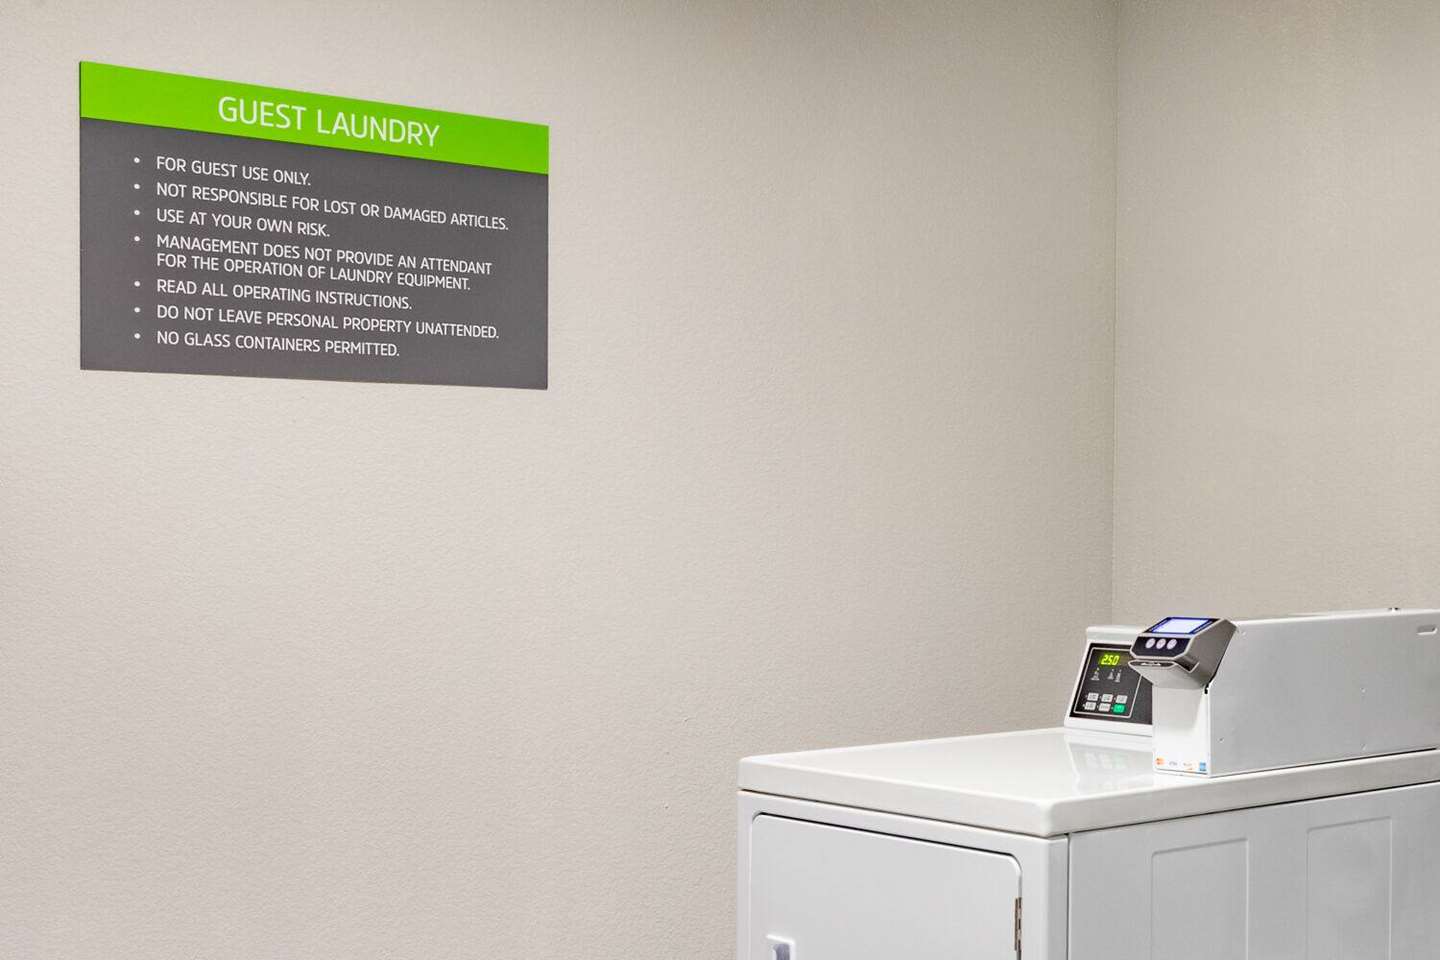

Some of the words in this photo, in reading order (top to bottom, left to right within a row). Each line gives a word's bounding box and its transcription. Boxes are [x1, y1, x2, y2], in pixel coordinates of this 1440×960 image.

[217, 95, 306, 130] GUEST
[316, 109, 439, 147] LAUNDRY
[156, 155, 187, 173] FOR
[190, 159, 238, 178] GUEST
[241, 164, 269, 182] USE
[272, 168, 312, 186] ONLY.
[156, 181, 188, 198] NOT
[191, 185, 288, 209] RESPONSIBLE
[291, 195, 320, 212] FOR
[323, 198, 357, 215] LOST
[359, 202, 380, 218] OR
[383, 204, 447, 224] DAMAGED
[449, 212, 509, 231] ARTICLES.
[156, 207, 185, 224] USE
[188, 210, 208, 226] AT
[210, 212, 252, 230] YOUR
[255, 216, 293, 234] OWN
[296, 220, 330, 238] RISK.
[156, 233, 259, 256] MANAGEMENT
[262, 242, 301, 260] DOES
[304, 246, 333, 262] NOT
[336, 248, 394, 267] PROVIDE
[396, 254, 417, 269] AN
[419, 256, 493, 275] ATTENDANT
[156, 252, 187, 269] FOR
[190, 254, 220, 271] THE
[223, 257, 303, 278] OPERATION
[306, 264, 326, 279] OF
[329, 266, 394, 284] LAUNDRY
[396, 271, 471, 291] EQUIPMENT.
[156, 278, 197, 295] READ
[200, 281, 229, 297] ALL
[232, 283, 311, 303] OPERATING
[315, 289, 412, 310] INSTRUCTIONS.
[156, 303, 179, 320] DO
[183, 305, 215, 321] NOT
[218, 308, 262, 325] LEAVE
[266, 311, 339, 329] PERSONAL
[342, 315, 412, 334] PROPERTY
[415, 320, 500, 339] UNATTENDED.
[156, 329, 180, 345] NO
[183, 331, 231, 348] GLASS
[234, 334, 321, 353] CONTAINERS
[324, 339, 400, 357] PERMITTED.
